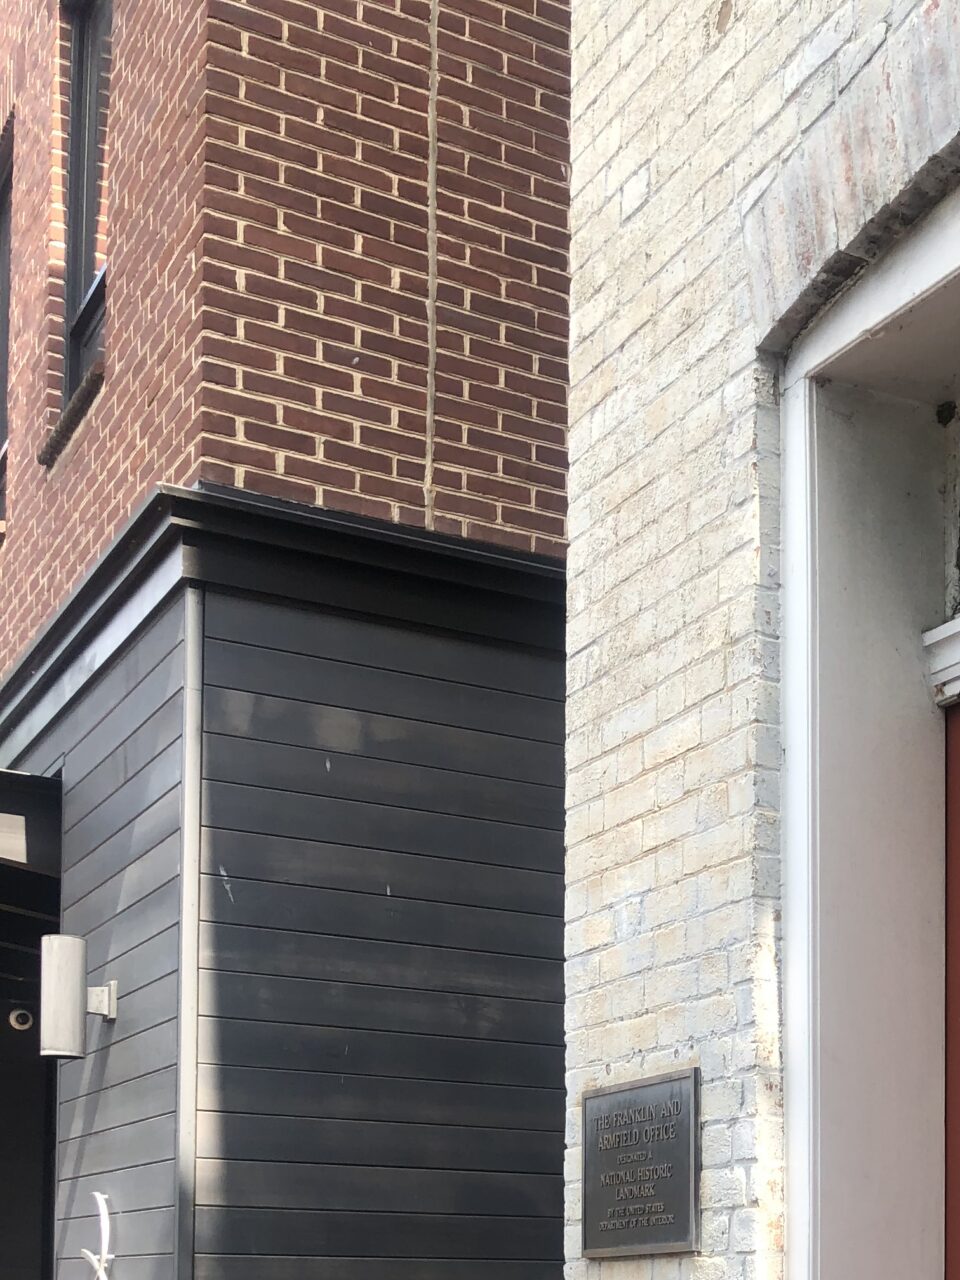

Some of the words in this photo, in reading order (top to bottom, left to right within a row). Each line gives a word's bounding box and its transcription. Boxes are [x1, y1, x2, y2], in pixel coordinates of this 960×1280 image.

[593, 1113, 611, 1131] THE
[613, 1104, 657, 1128] FRANKLIN
[661, 1099, 682, 1118] AND
[598, 1128, 640, 1151] ARMFIELD
[643, 1122, 677, 1143] OFFICE
[600, 1169, 636, 1187] NATIONAL
[637, 1163, 672, 1181] HISTORIC
[615, 1183, 656, 1201] LANDMARK
